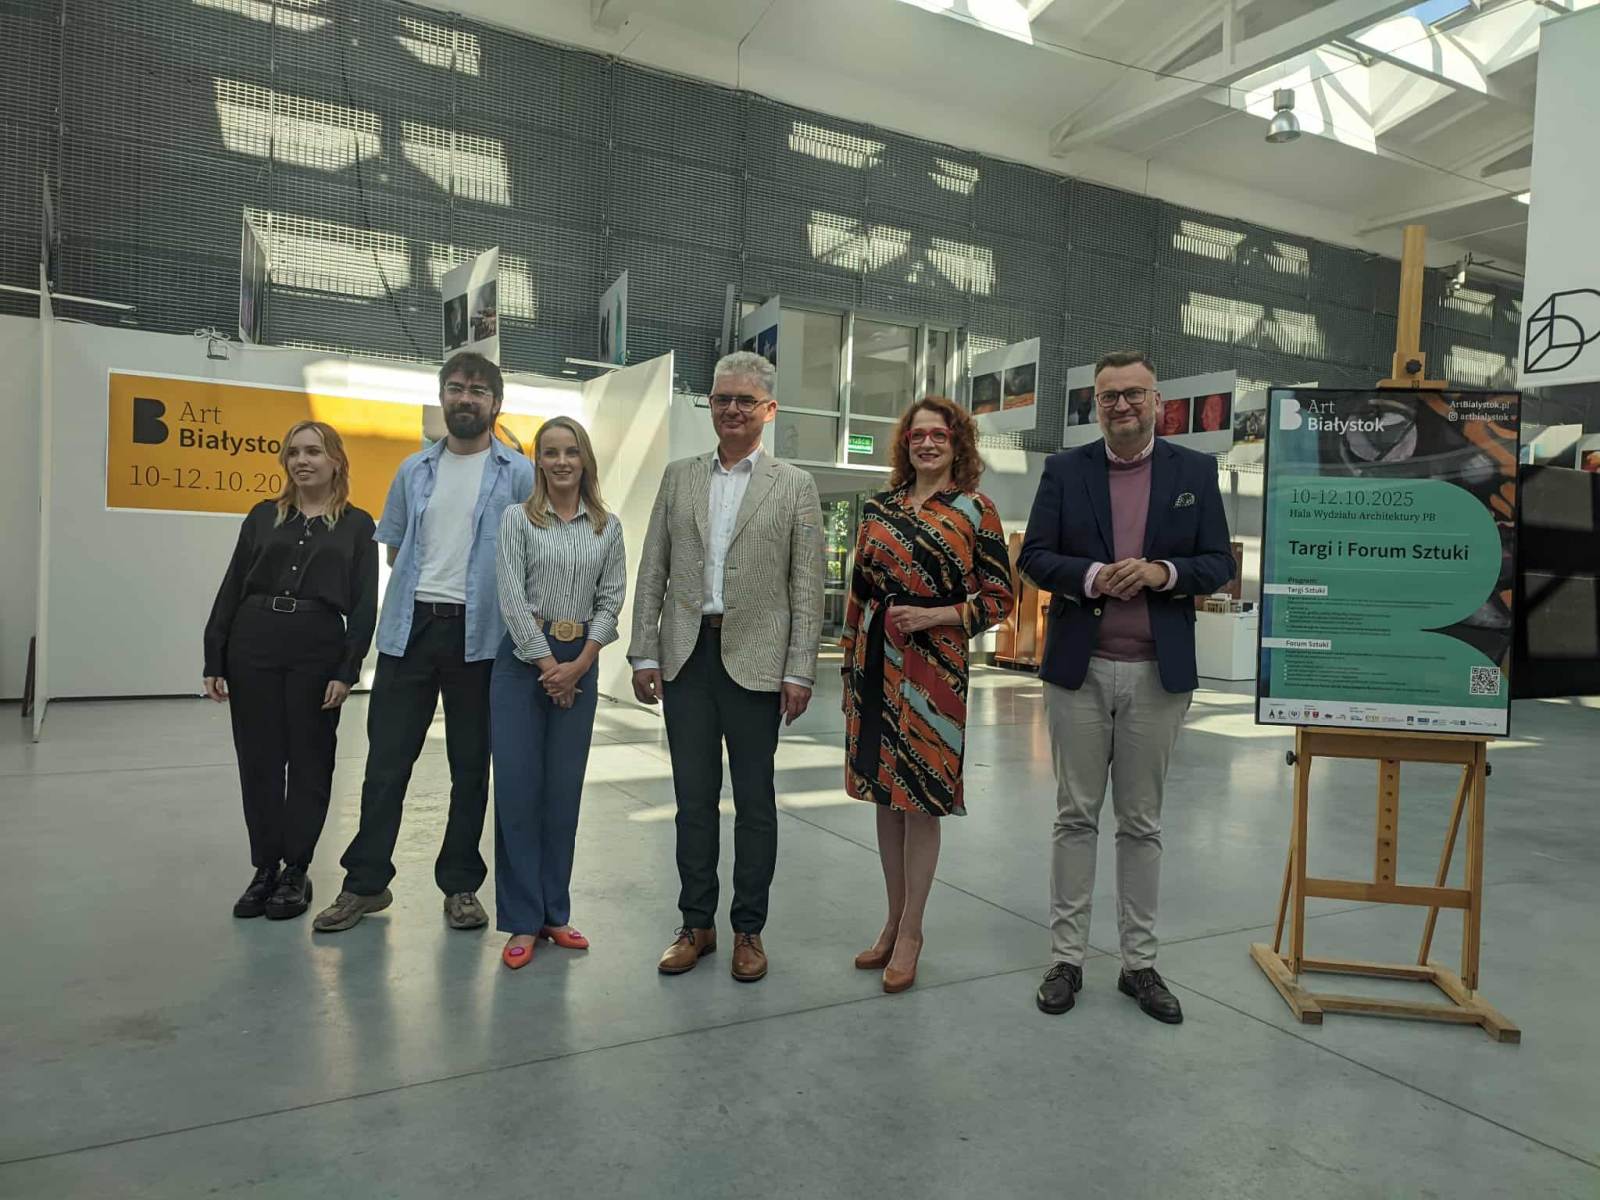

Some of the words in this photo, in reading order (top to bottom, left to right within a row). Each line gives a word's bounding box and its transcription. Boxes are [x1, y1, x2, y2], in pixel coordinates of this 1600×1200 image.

[179, 401, 222, 425] Art
[1308, 399, 1335, 414] Art
[1308, 417, 1385, 435] Białystok
[179, 428, 282, 456] Białysto
[129, 464, 283, 494] 10-12.10.20
[1291, 488, 1414, 507] 10-12.10.2025
[1289, 509, 1311, 518] Hala
[1314, 510, 1357, 520] Wydziału
[1359, 512, 1420, 523] Architektury
[1423, 513, 1436, 522] PB
[1289, 541, 1332, 559] Targi
[1338, 541, 1342, 556] i
[1347, 542, 1406, 559] Forum
[1412, 544, 1469, 561] Sztuki
[1287, 586, 1304, 594] Targi
[1286, 639, 1308, 647] Forum
[1308, 640, 1329, 648] Sztuki
